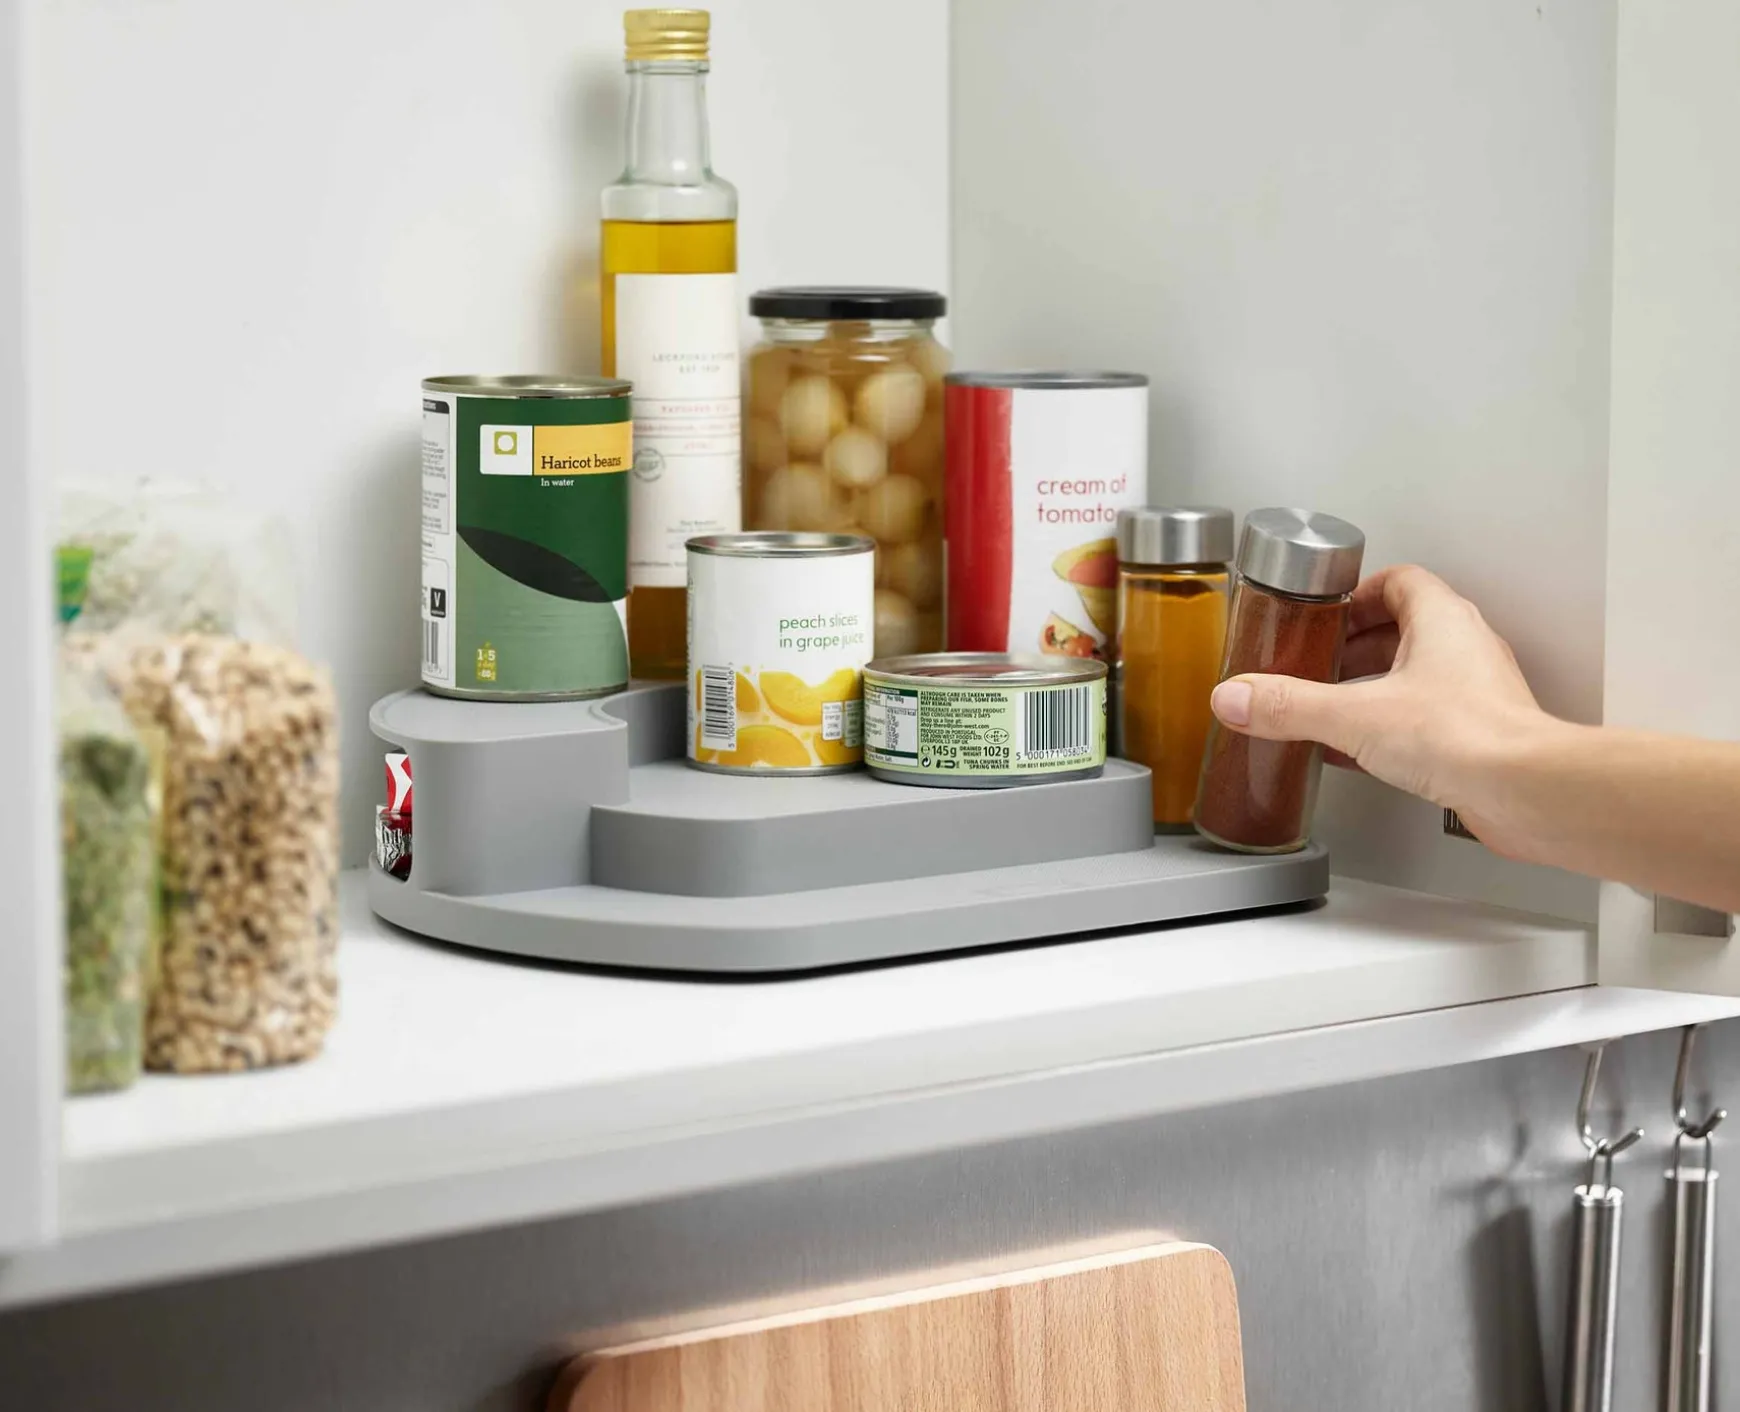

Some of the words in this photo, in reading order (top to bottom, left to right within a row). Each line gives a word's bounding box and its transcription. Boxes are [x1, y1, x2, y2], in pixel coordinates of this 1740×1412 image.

[541, 456, 591, 469] Haricot
[594, 454, 622, 468] beans
[541, 478, 550, 486] In
[1037, 479, 1106, 495] cream
[1111, 474, 1126, 493] of
[1037, 503, 1115, 522] tomato
[434, 591, 441, 608] V
[779, 614, 826, 632] peach
[830, 613, 858, 628] slices
[780, 634, 792, 648] in
[796, 636, 840, 652] grape
[842, 632, 864, 648] juice
[1016, 752, 1021, 760] 5
[1028, 750, 1059, 760] 000171
